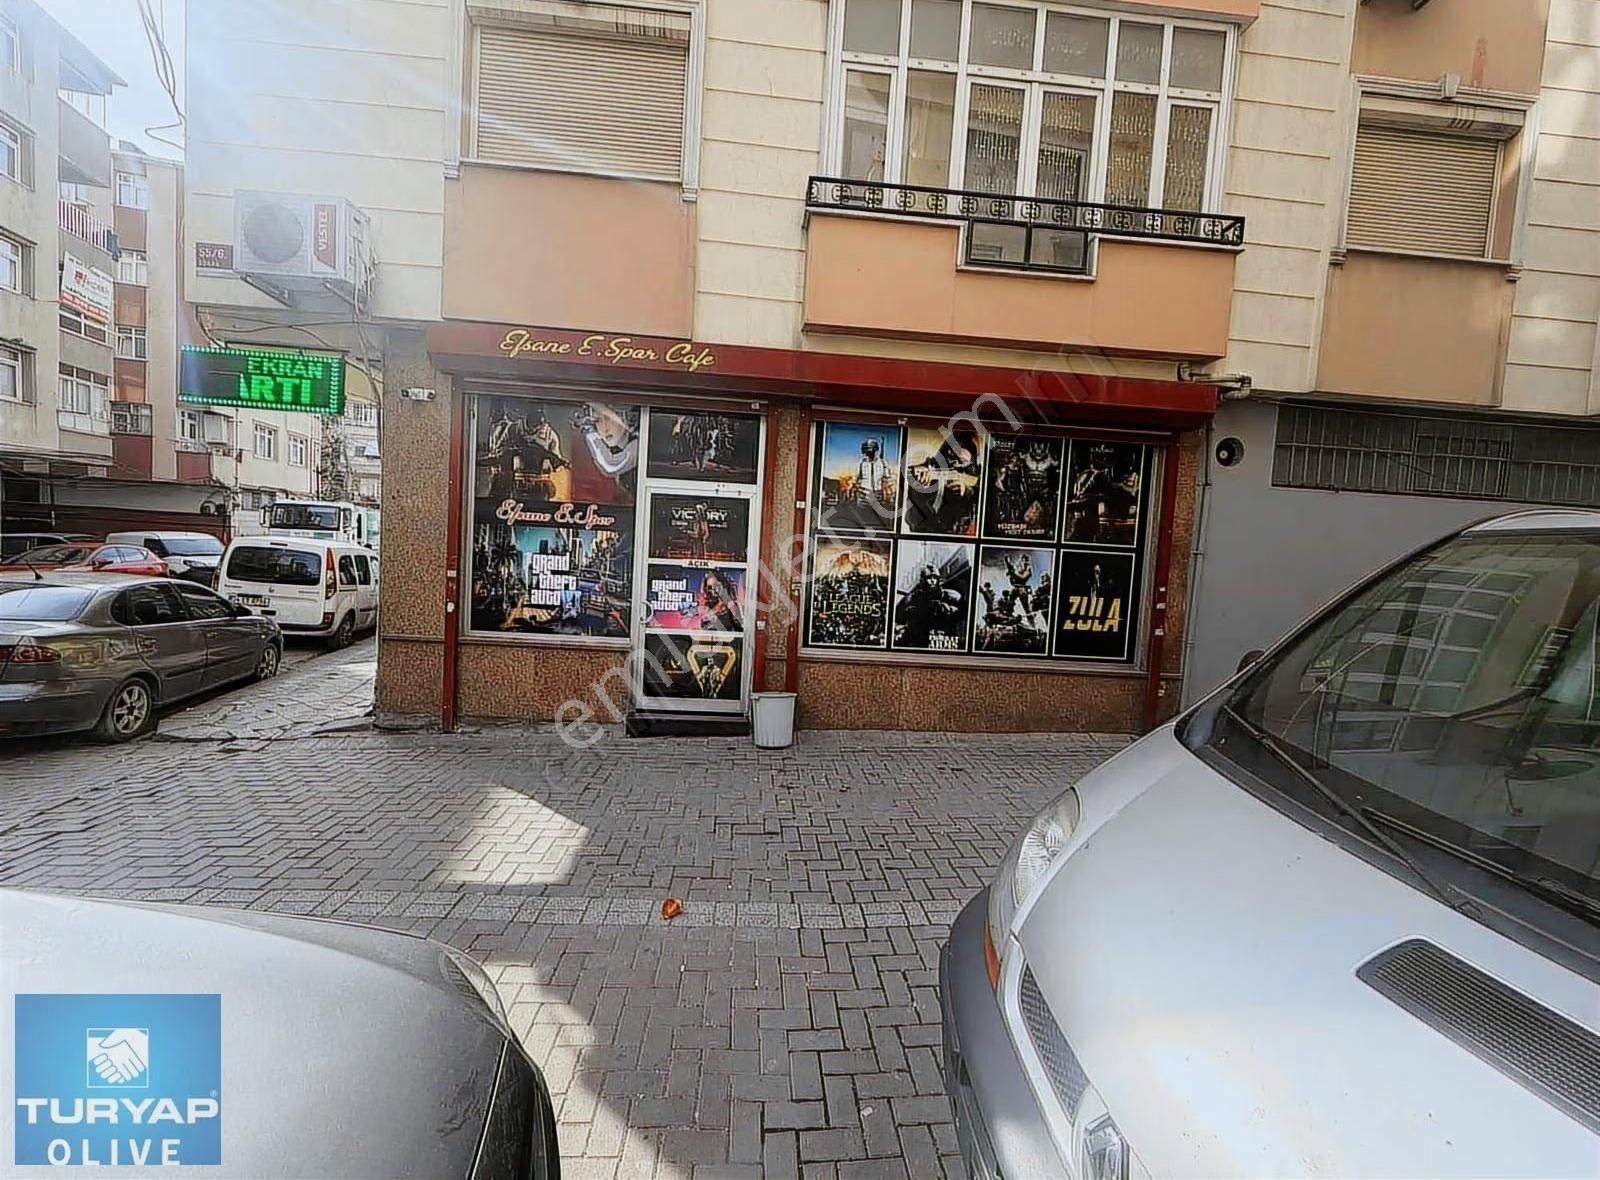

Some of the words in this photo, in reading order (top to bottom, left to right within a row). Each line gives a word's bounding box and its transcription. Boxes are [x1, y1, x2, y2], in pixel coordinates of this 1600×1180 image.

[500, 329, 572, 358] Efsane
[665, 343, 716, 372] Cafe
[247, 357, 323, 379] EKRAN
[532, 552, 570, 575] grand
[539, 573, 577, 590] theft
[651, 579, 687, 592] grand
[531, 589, 561, 606] auto
[823, 600, 881, 617] LEGENDS
[1063, 595, 1121, 632] ZULA
